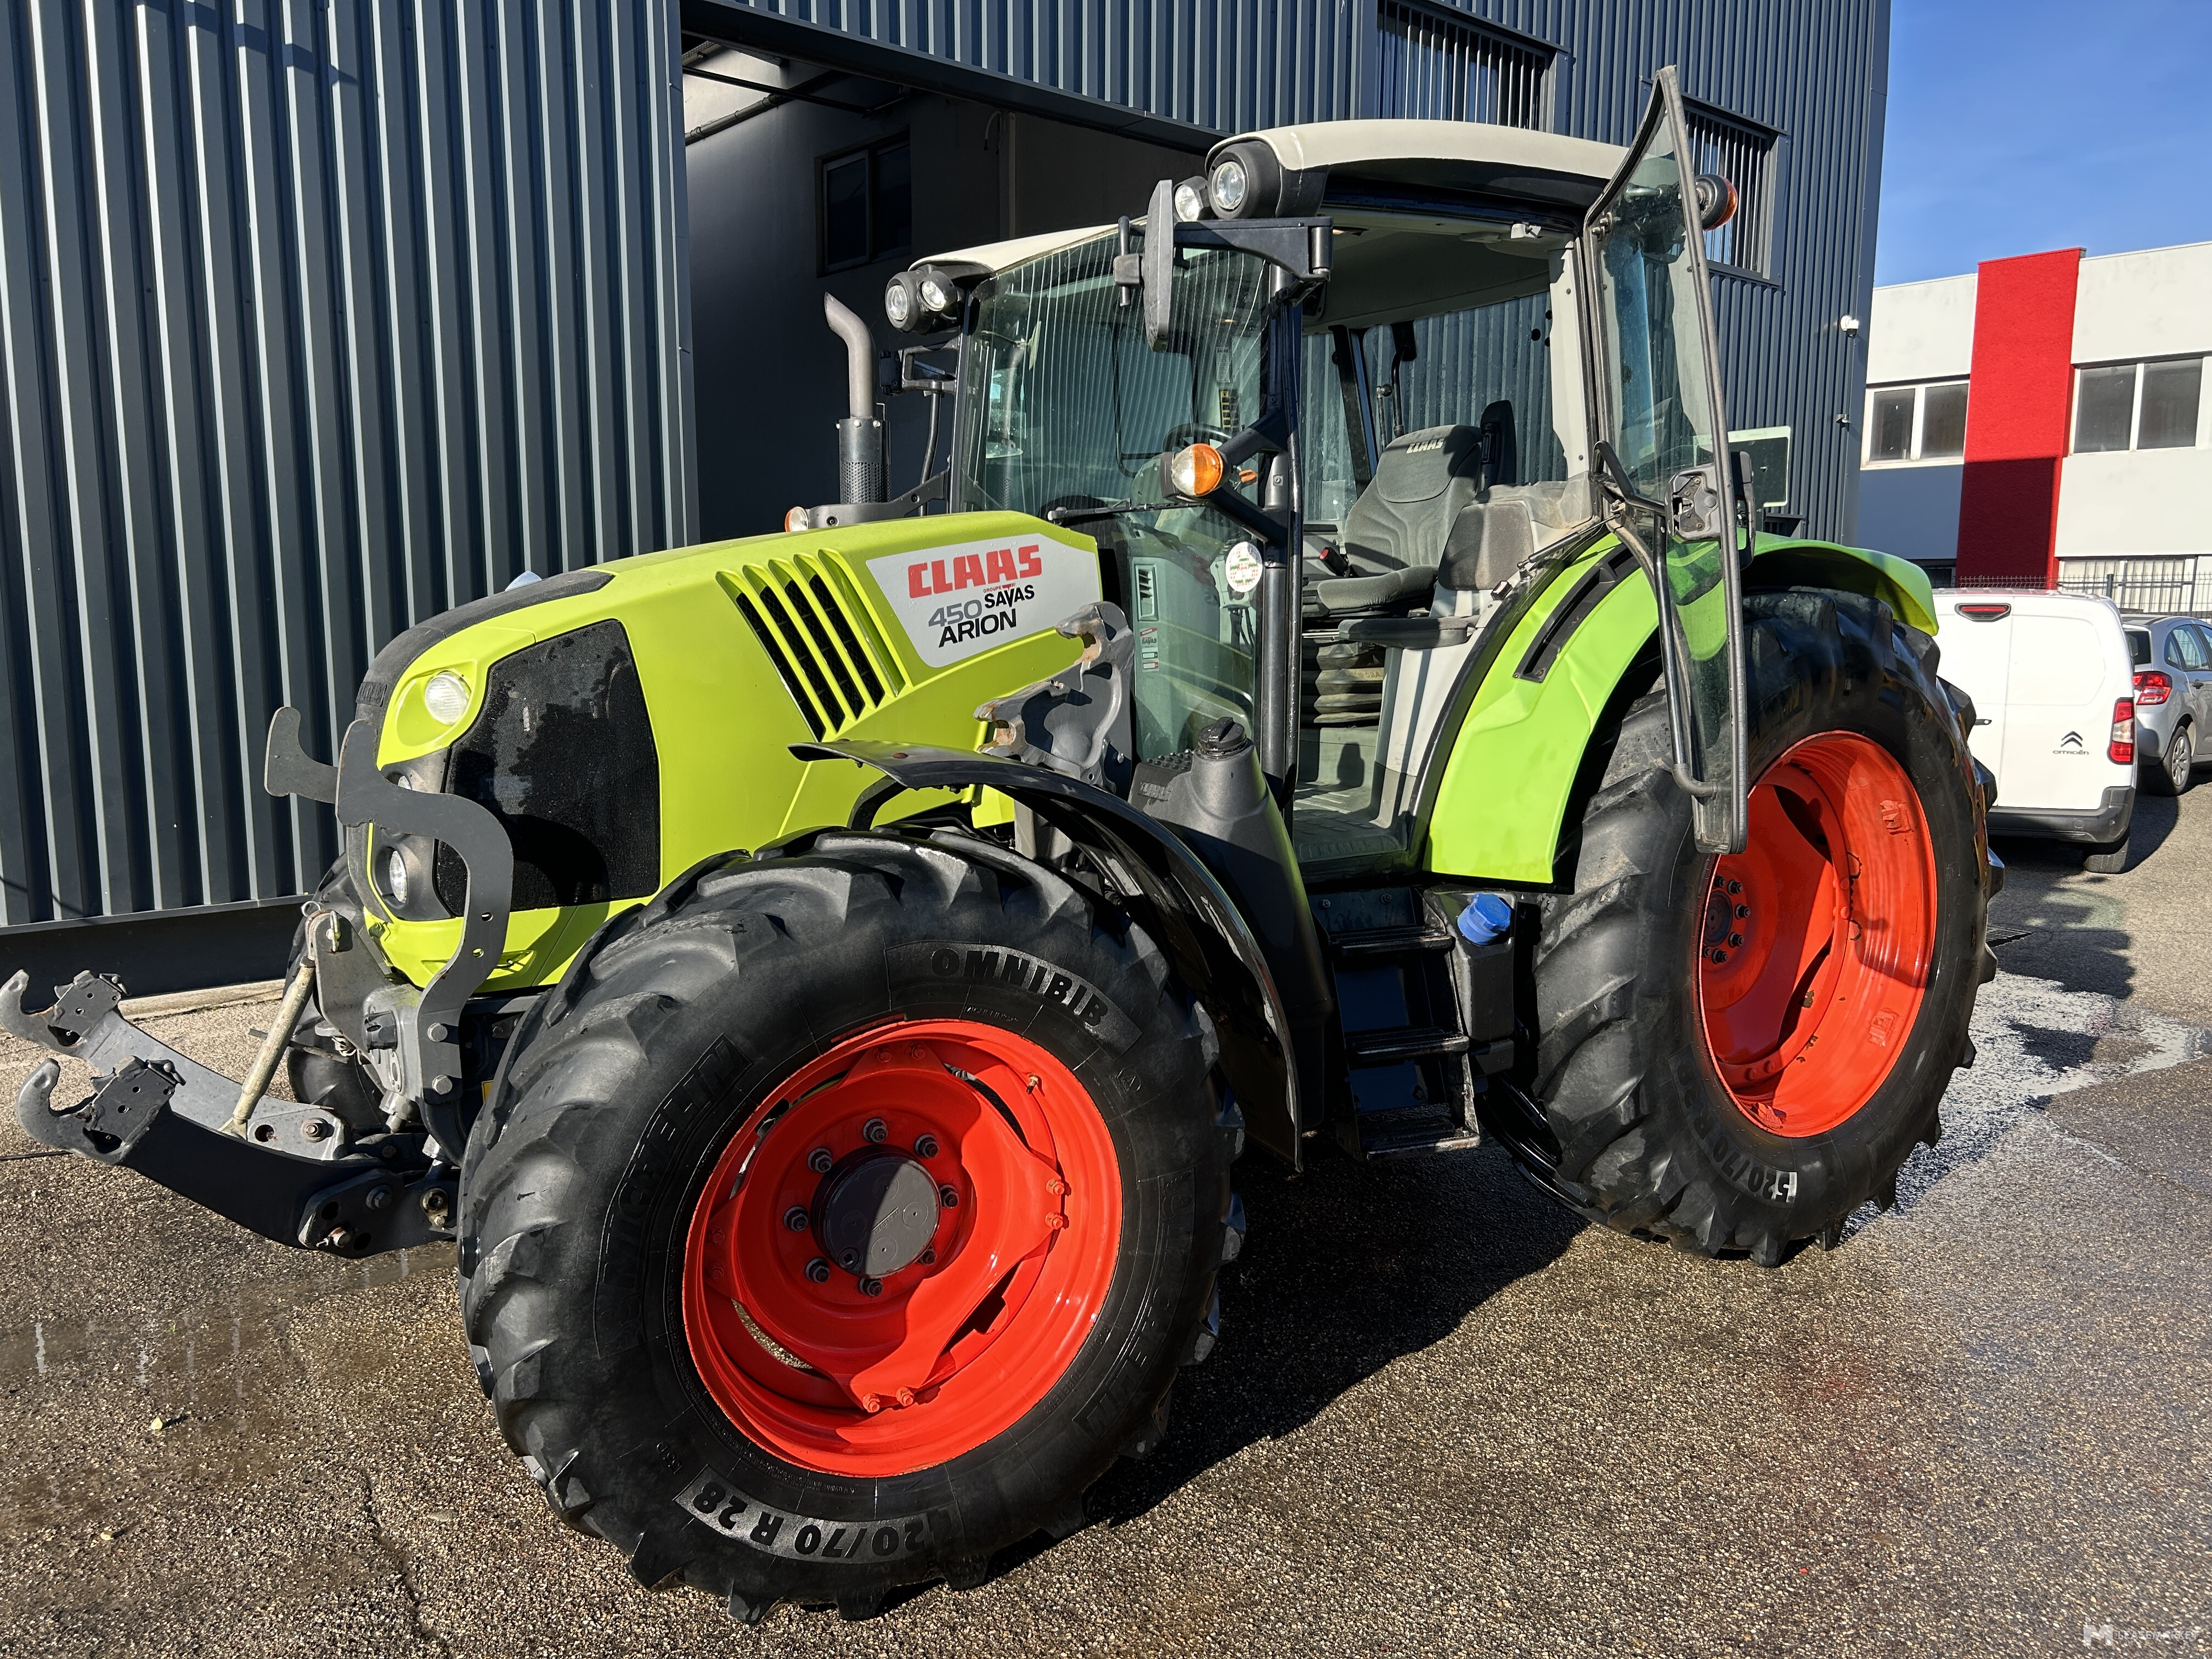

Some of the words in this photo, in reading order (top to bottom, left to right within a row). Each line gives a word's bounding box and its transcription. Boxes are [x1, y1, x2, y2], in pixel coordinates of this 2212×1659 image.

[1406, 438, 1445, 454] CLAAS
[908, 545, 1042, 599] CLAAS
[928, 599, 983, 627] 450
[984, 584, 1035, 608] SAVAS
[939, 608, 1017, 648] ARION
[931, 948, 1109, 1027] OMNIBIB
[1713, 1135, 1790, 1203] 520/70
[873, 1218, 889, 1234] LEVEL
[890, 1210, 900, 1218] OIL
[693, 1481, 749, 1531] 28
[749, 1511, 783, 1547] R
